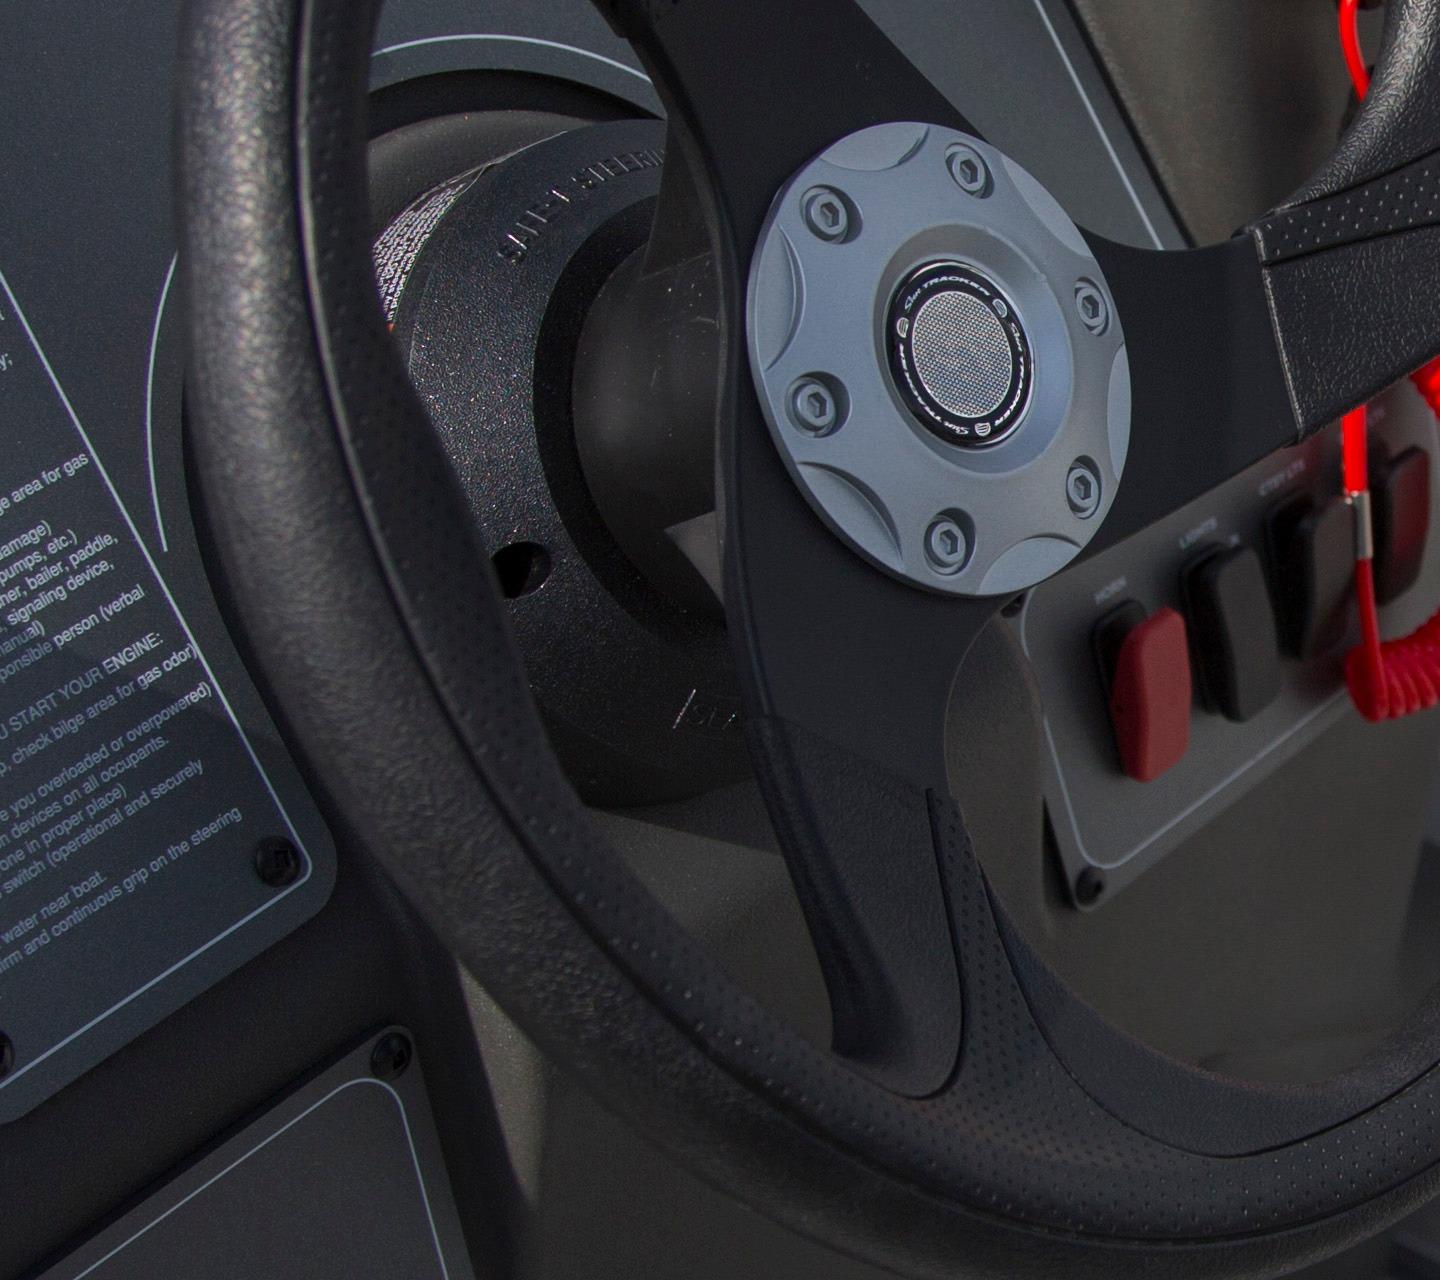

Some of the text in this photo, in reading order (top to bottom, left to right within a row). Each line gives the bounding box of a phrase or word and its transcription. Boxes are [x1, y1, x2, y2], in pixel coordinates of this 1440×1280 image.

[7, 691, 59, 733] START
[57, 665, 104, 701] YOUR
[101, 630, 164, 674] ENGINE:
[9, 792, 38, 818] you
[36, 742, 110, 798] overloaded
[109, 735, 125, 752] or
[125, 679, 212, 744] overpowered)
[0, 911, 39, 945] water
[39, 892, 72, 920] near
[69, 868, 107, 899] boat.
